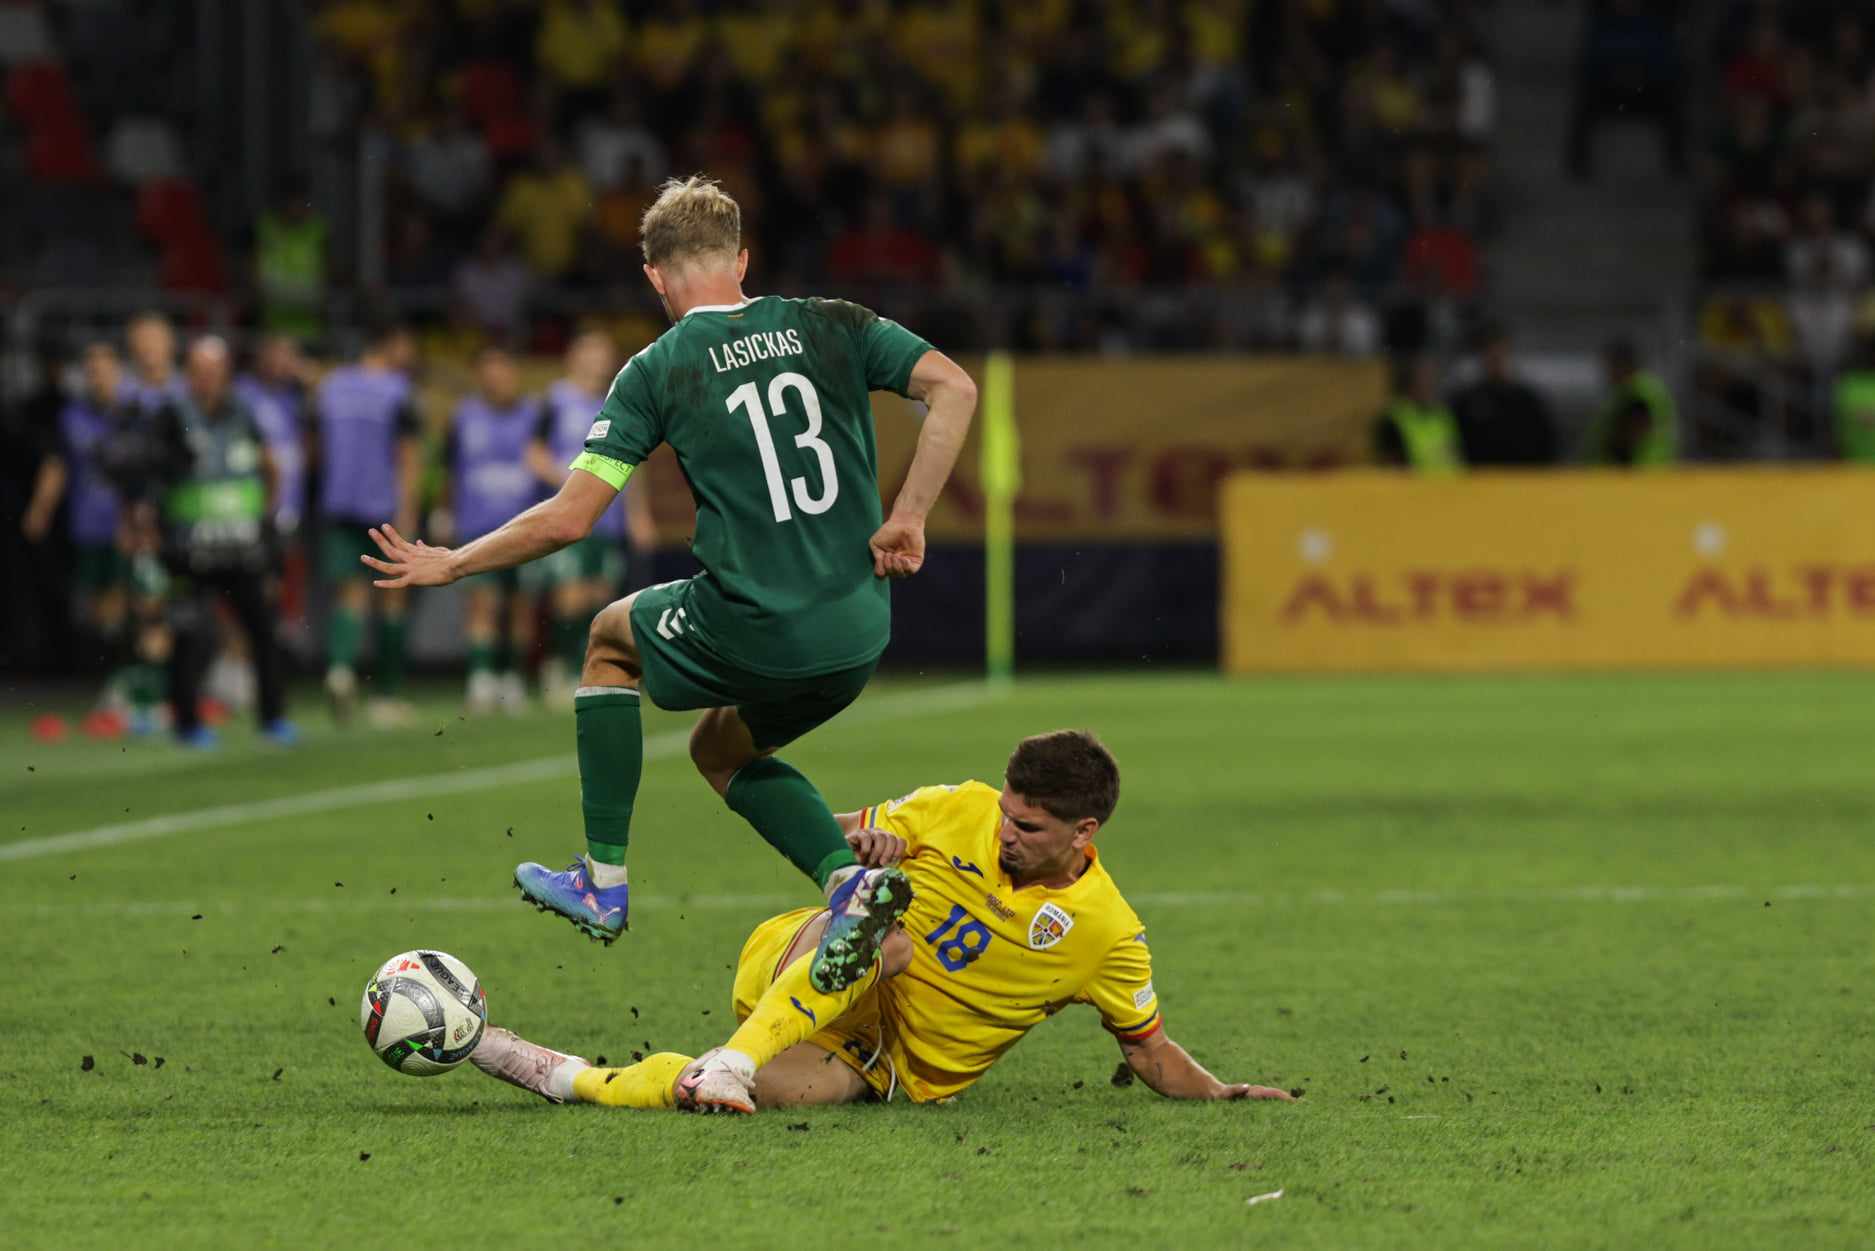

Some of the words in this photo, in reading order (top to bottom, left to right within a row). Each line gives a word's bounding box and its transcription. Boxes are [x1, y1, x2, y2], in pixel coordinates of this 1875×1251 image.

[708, 328, 803, 373] LASICKAS
[725, 371, 839, 523] 13
[924, 904, 992, 972] 18
